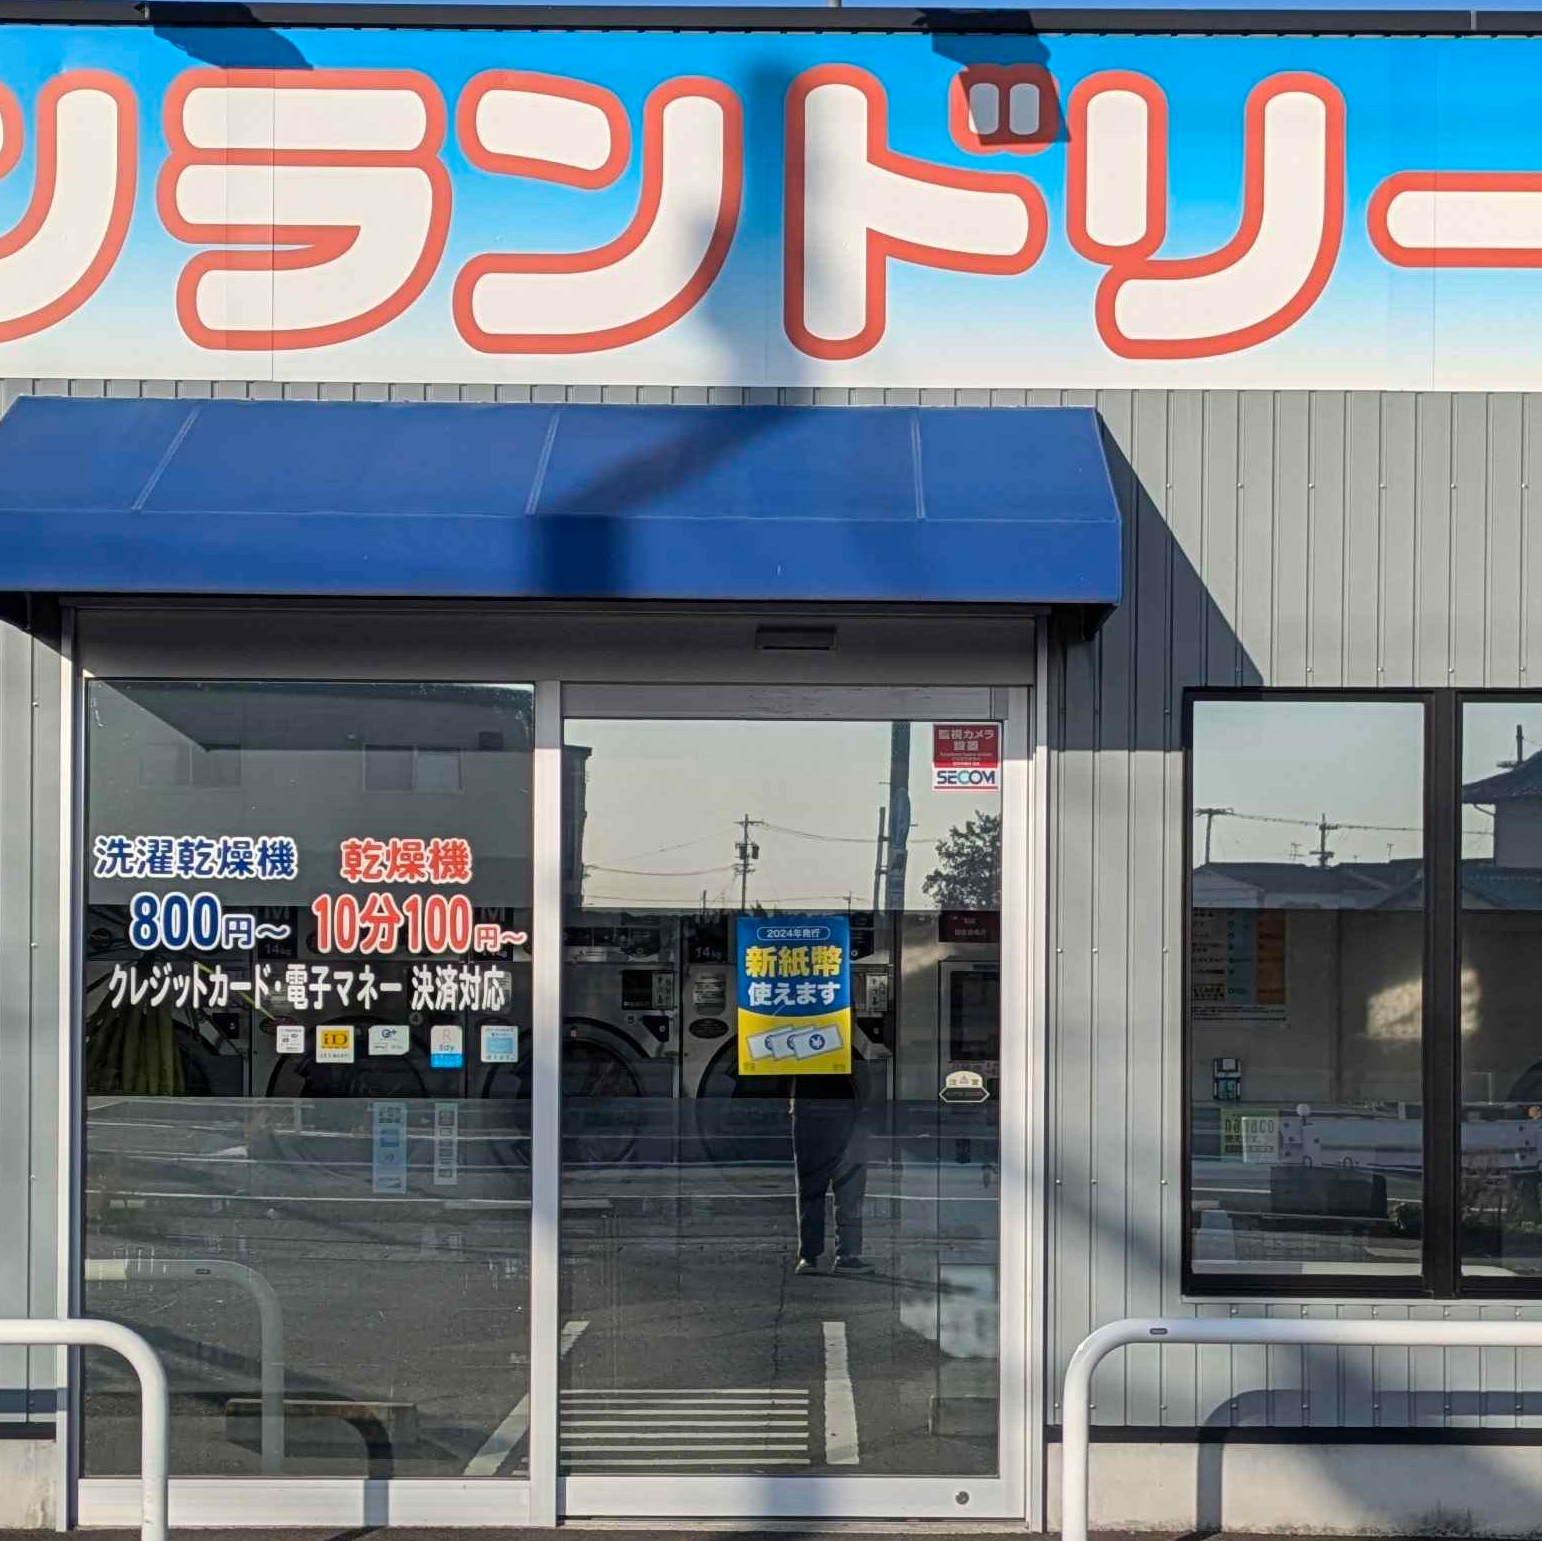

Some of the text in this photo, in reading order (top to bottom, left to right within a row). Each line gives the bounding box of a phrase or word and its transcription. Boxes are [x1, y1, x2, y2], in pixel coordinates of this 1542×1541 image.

[936, 769, 996, 785] SECOM
[93, 834, 298, 880] 洗濯乾燥機
[340, 837, 474, 884] 乾燥機
[745, 945, 843, 978] 新紙幣
[107, 962, 507, 1012] クレジットカード・電子マネー 決済対応
[747, 981, 842, 1007] 使えます
[323, 1032, 348, 1047] iD
